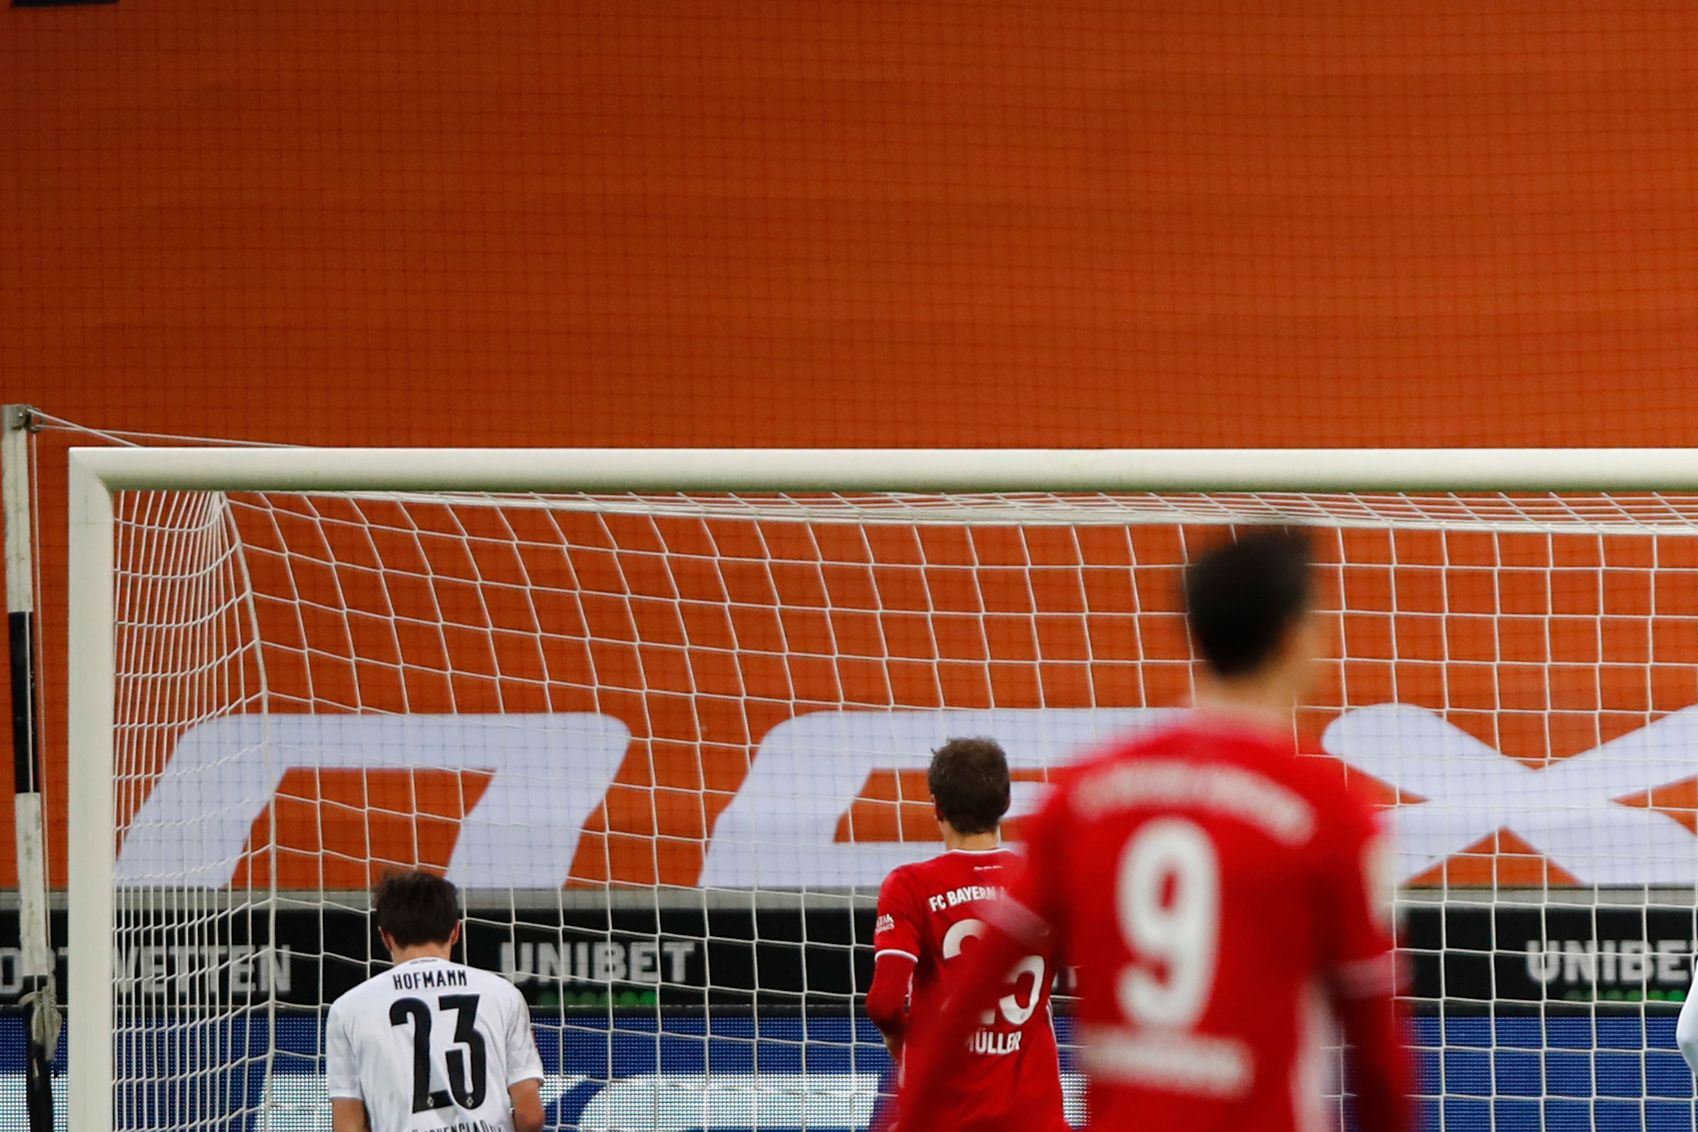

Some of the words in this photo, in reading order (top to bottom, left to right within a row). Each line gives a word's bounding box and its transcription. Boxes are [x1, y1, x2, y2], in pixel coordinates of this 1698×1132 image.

[929, 894, 946, 912] FC
[947, 886, 996, 907] BAYERN
[1114, 816, 1222, 1031] 9
[393, 970, 467, 990] HOFMANN
[501, 941, 695, 983] UNIBET
[389, 994, 487, 1113] 23
